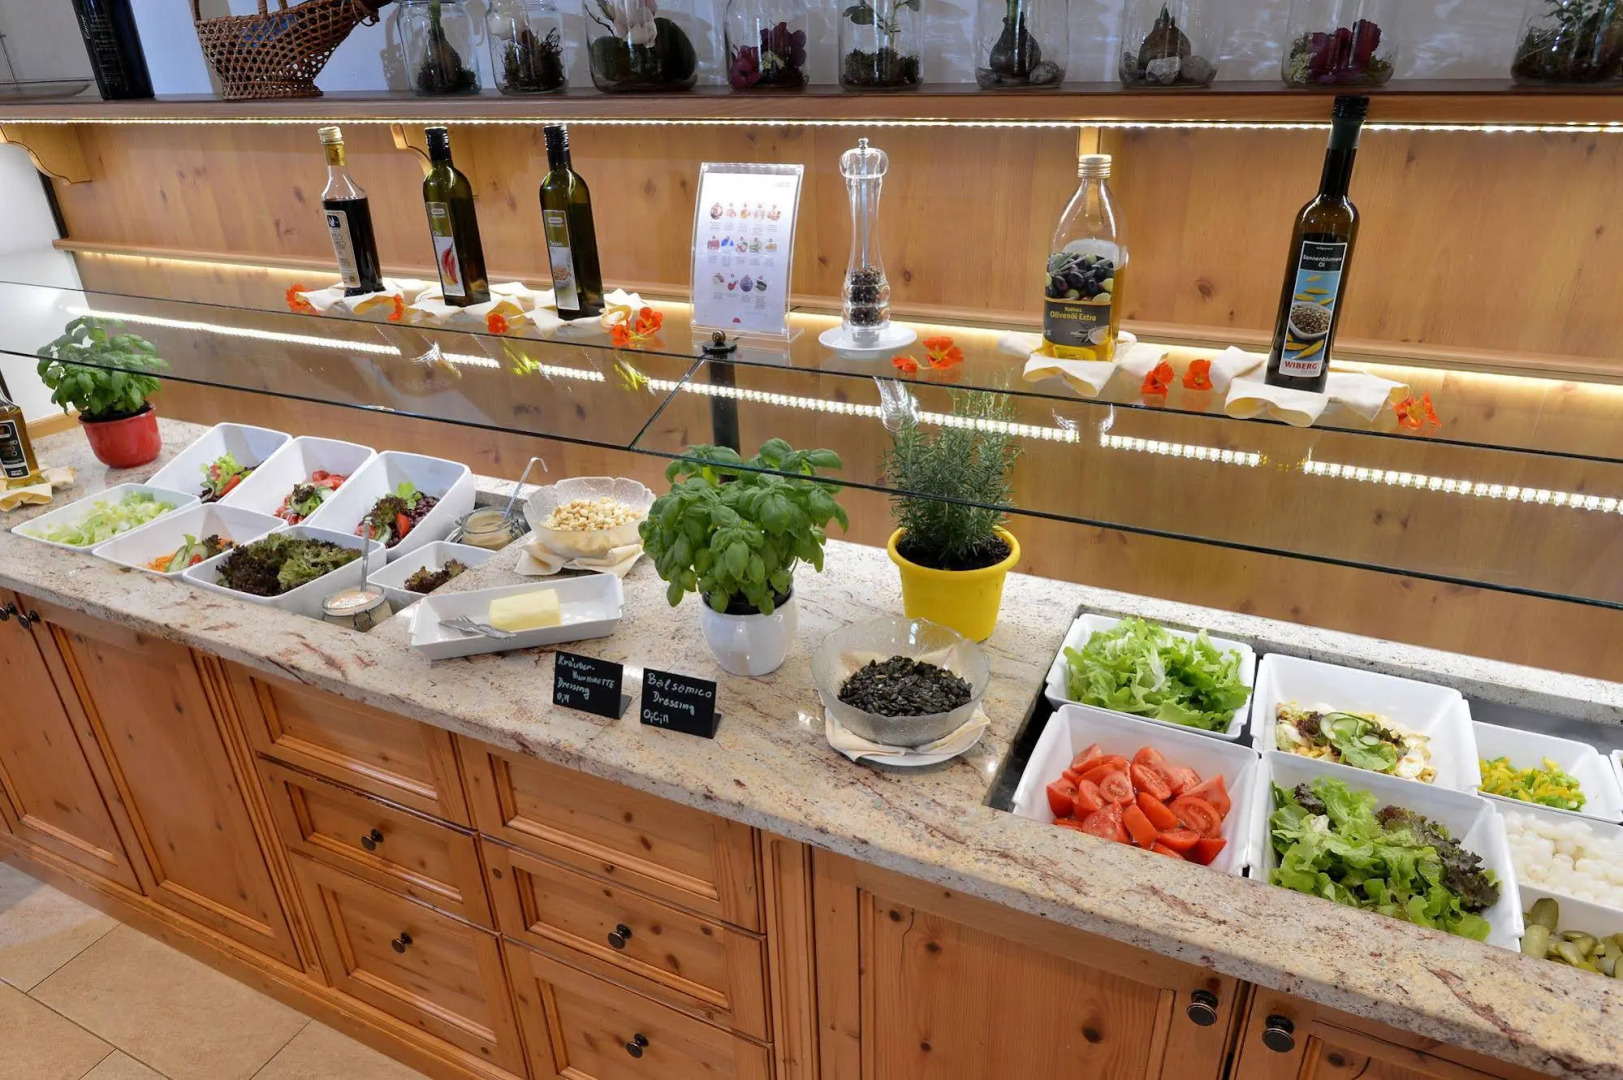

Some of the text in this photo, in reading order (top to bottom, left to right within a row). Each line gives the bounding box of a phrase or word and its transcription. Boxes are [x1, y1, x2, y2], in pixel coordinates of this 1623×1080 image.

[1049, 310, 1097, 321] Olivenöl Extra
[1285, 361, 1319, 370] WIBERG
[557, 677, 590, 701] Dressing
[647, 672, 712, 698] Balsamico
[652, 690, 695, 716] Dressing
